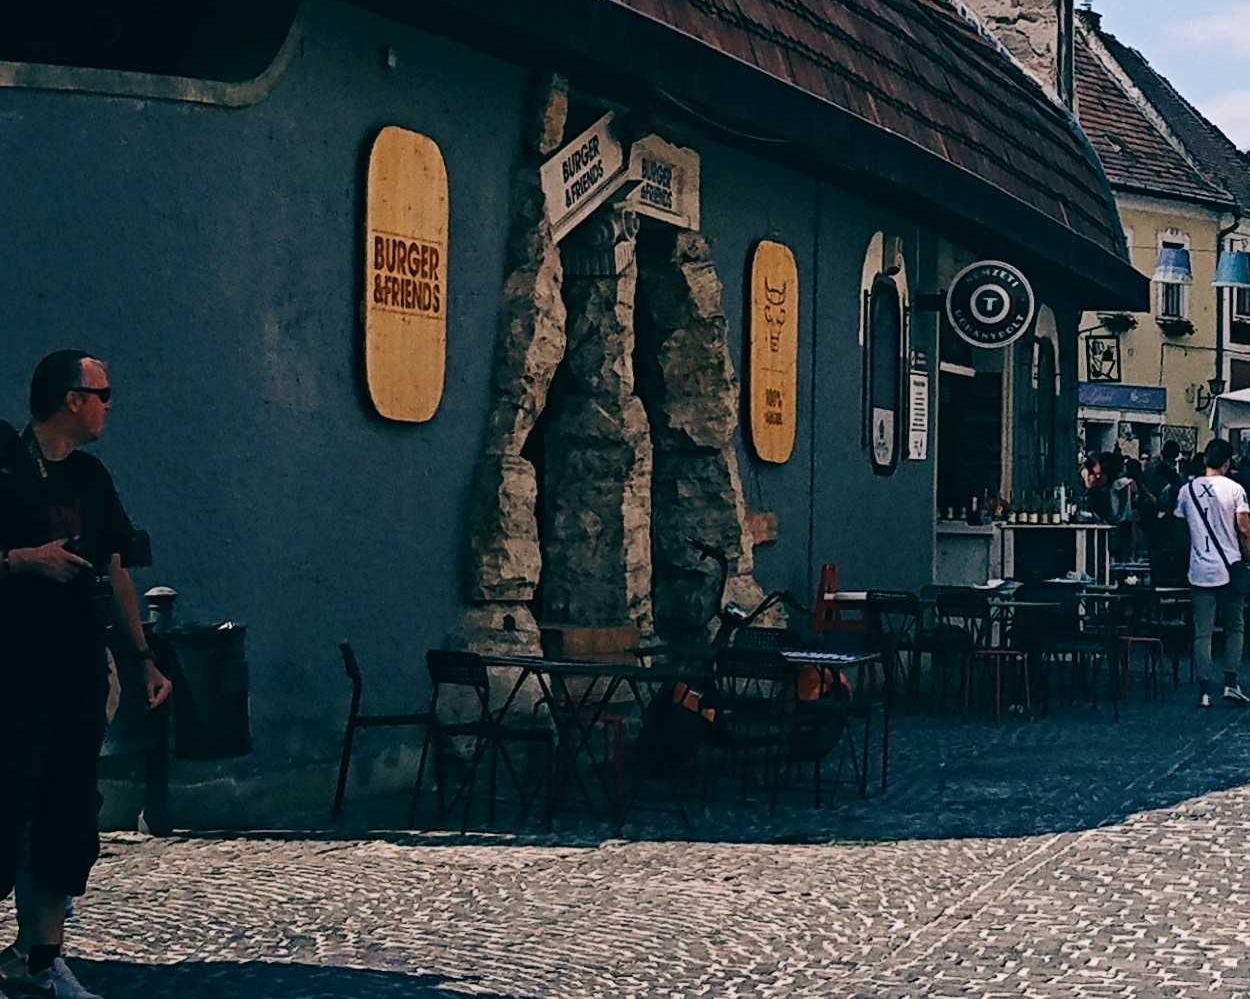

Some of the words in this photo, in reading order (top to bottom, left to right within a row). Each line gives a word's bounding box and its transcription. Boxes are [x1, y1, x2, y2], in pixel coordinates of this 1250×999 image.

[562, 134, 600, 183] BURGER
[374, 235, 439, 281] BURGER
[965, 268, 1019, 287] MZETI
[374, 273, 440, 313] &FRIENDS
[982, 297, 999, 311] T
